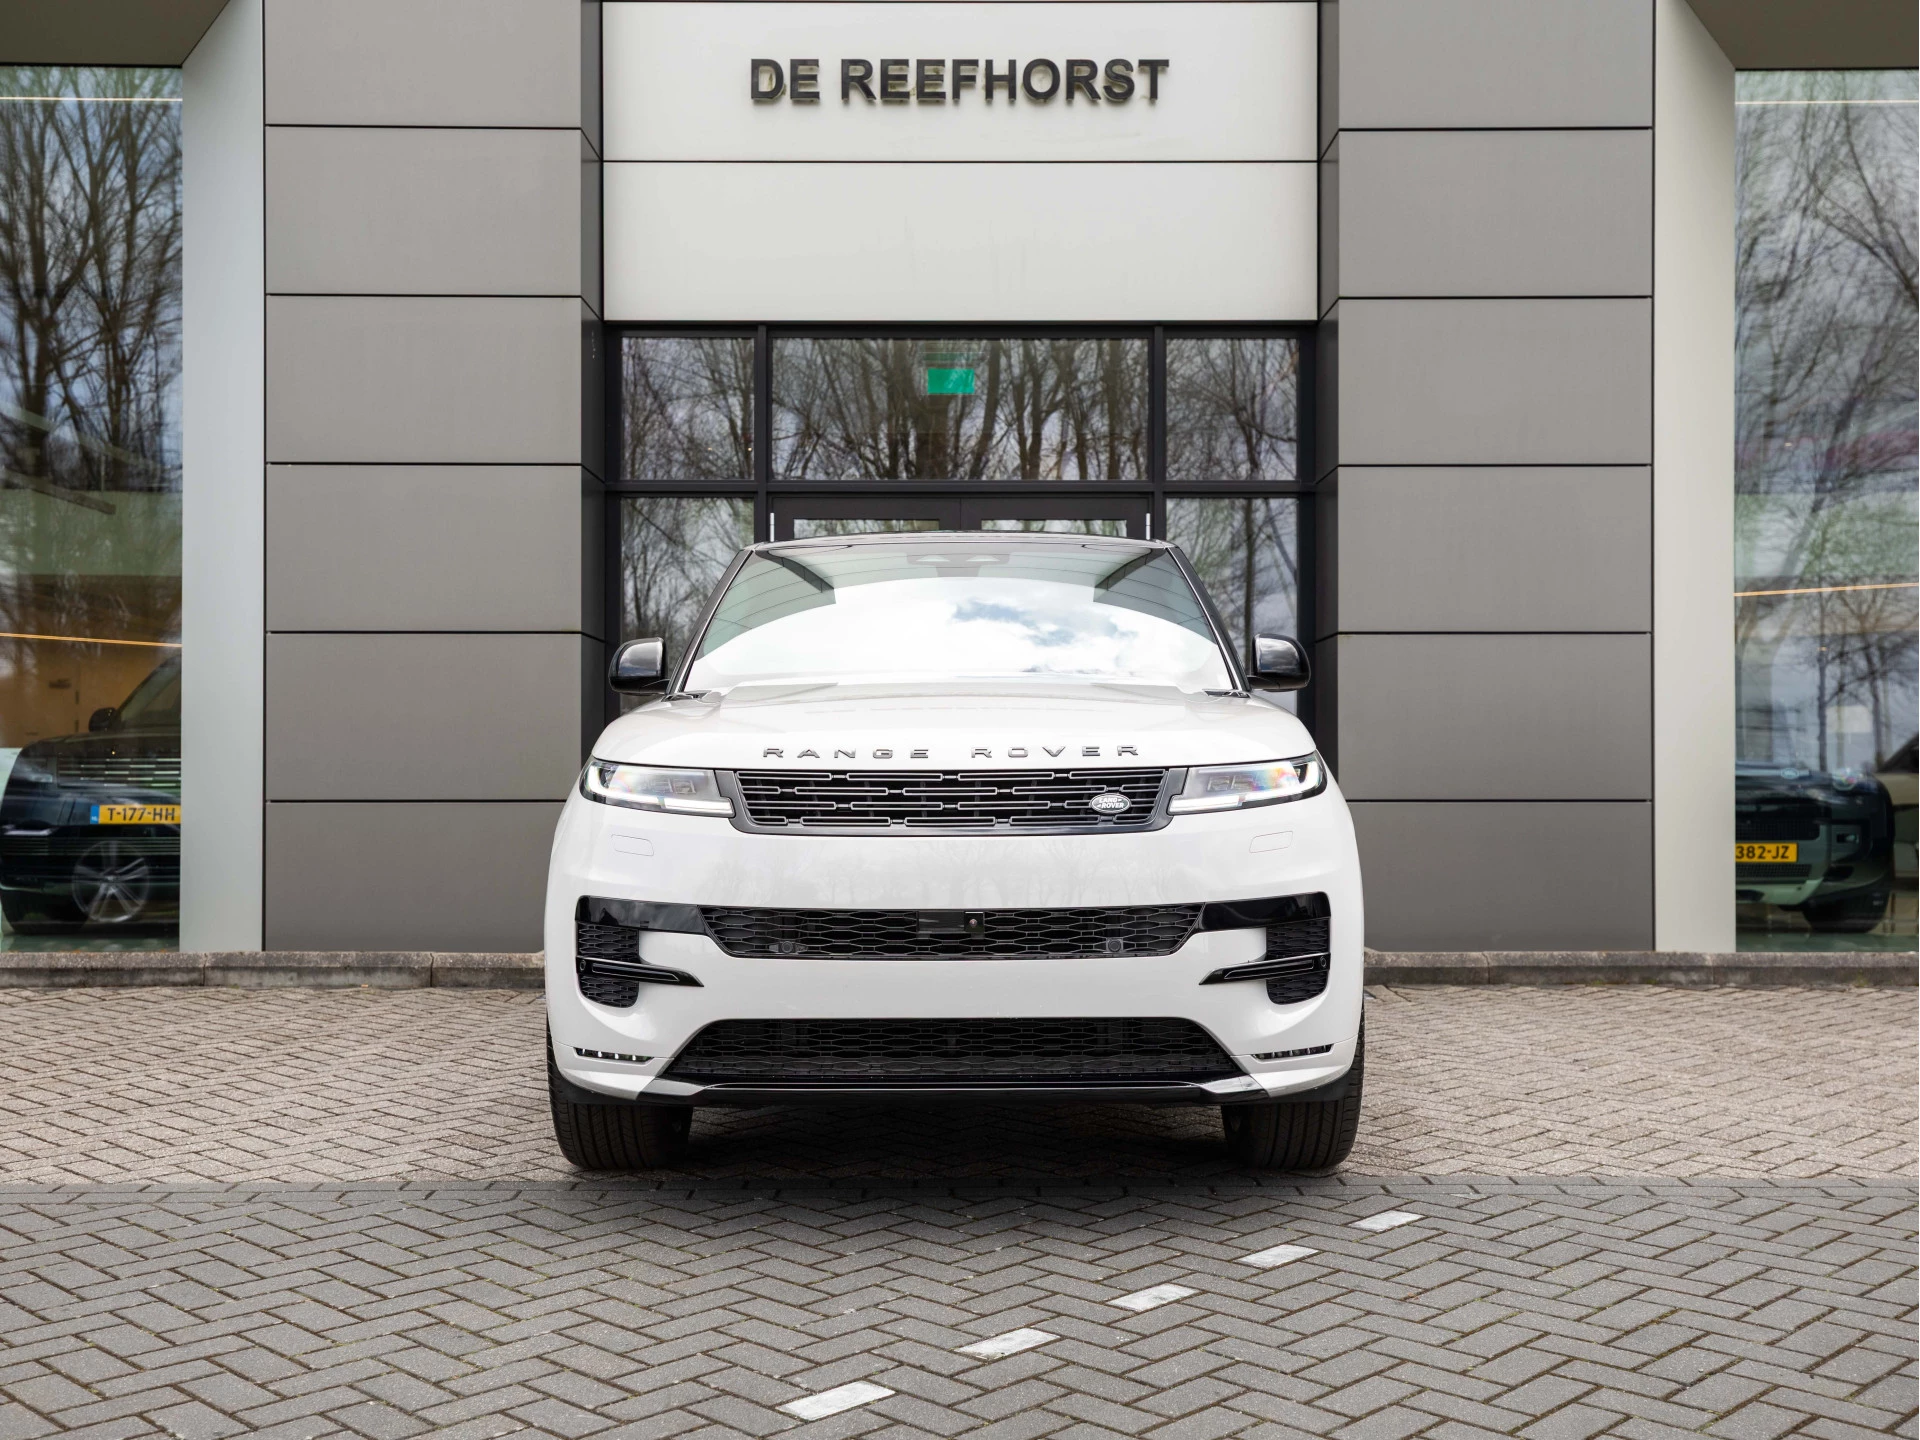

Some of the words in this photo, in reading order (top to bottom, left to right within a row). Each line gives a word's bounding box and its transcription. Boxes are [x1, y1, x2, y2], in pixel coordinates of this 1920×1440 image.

[751, 58, 820, 101] DE
[841, 58, 1170, 102] REEFHORST
[763, 748, 929, 759] RANGE
[971, 745, 1139, 758] ROVER
[107, 807, 175, 821] T-177-HH
